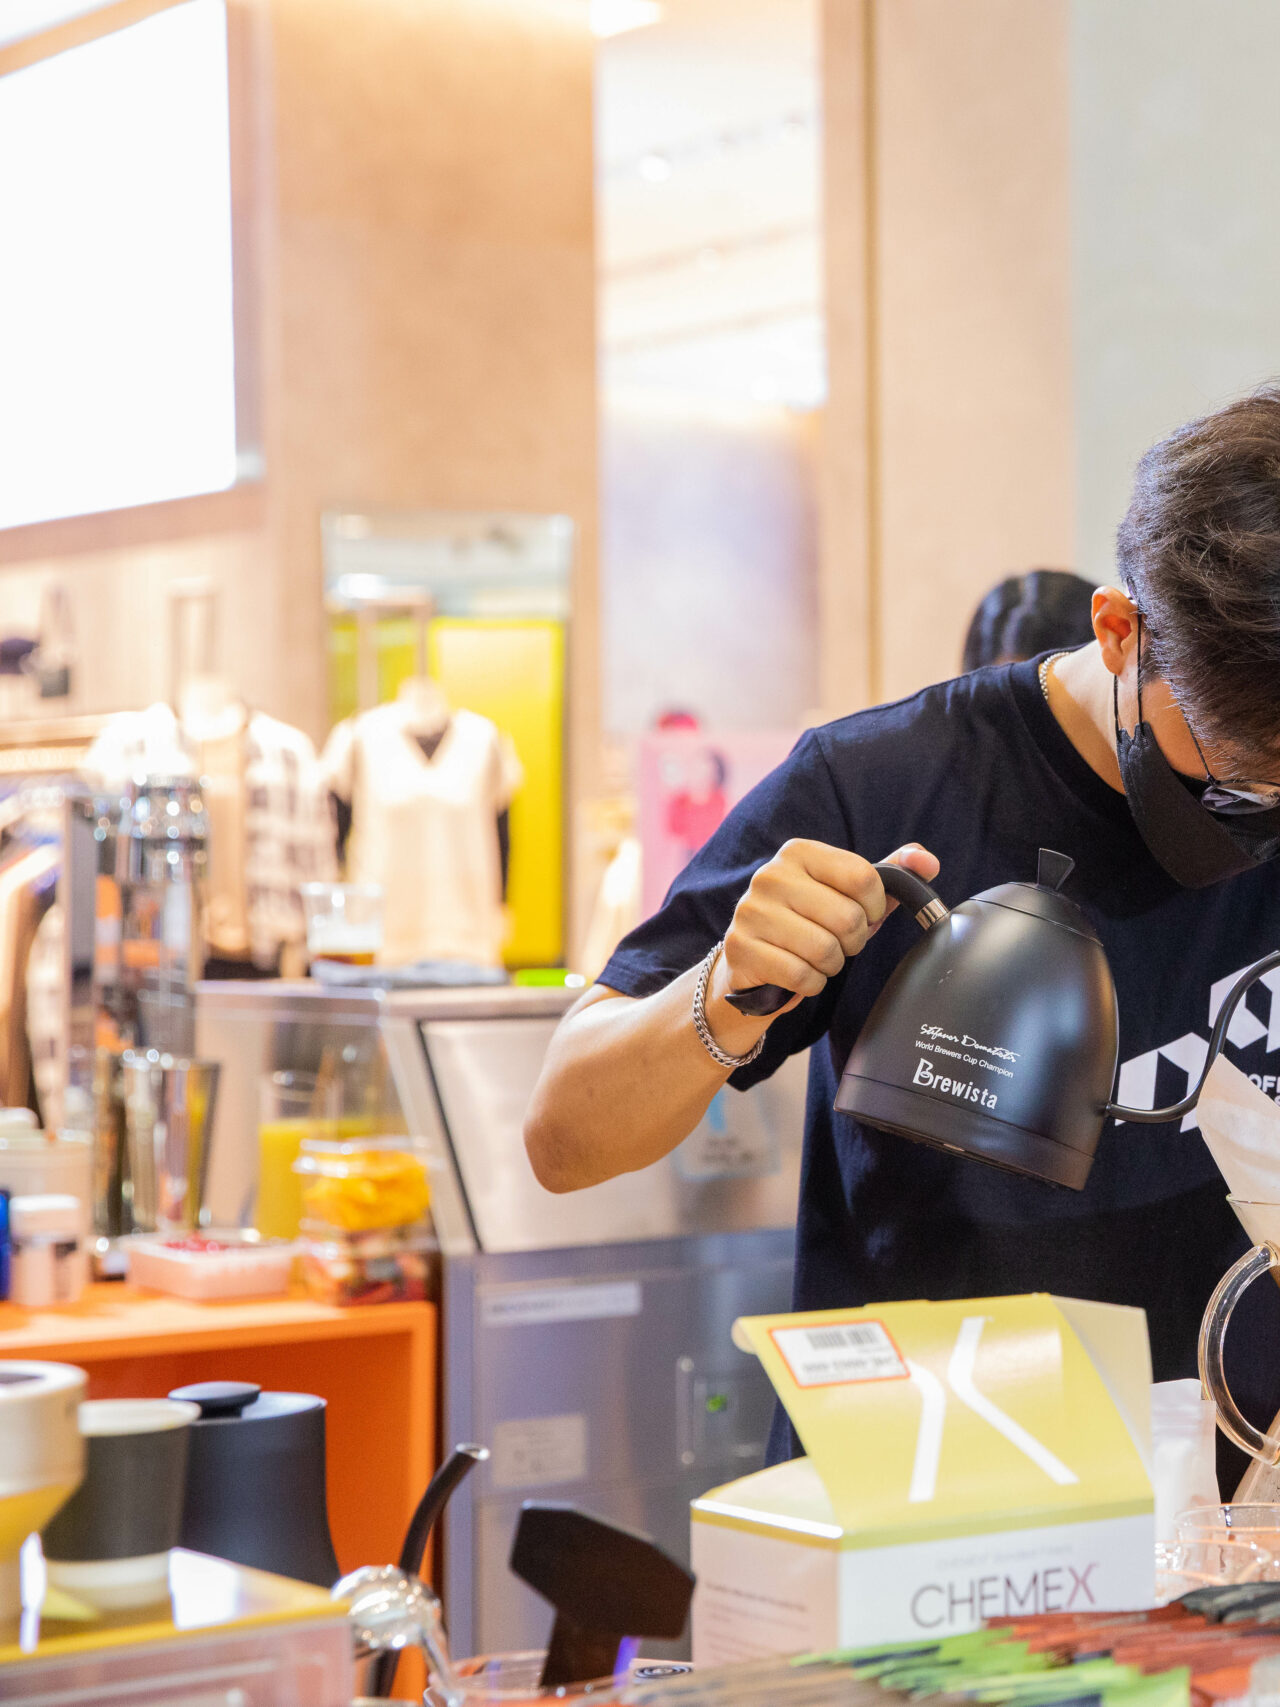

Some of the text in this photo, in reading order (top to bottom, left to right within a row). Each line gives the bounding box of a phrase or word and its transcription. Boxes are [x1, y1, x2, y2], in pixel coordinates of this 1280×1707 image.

[912, 1058, 998, 1109] Brewista
[915, 1040, 1014, 1078] World Brewers Cup Champion
[910, 1562, 1097, 1629] CHEMEX
